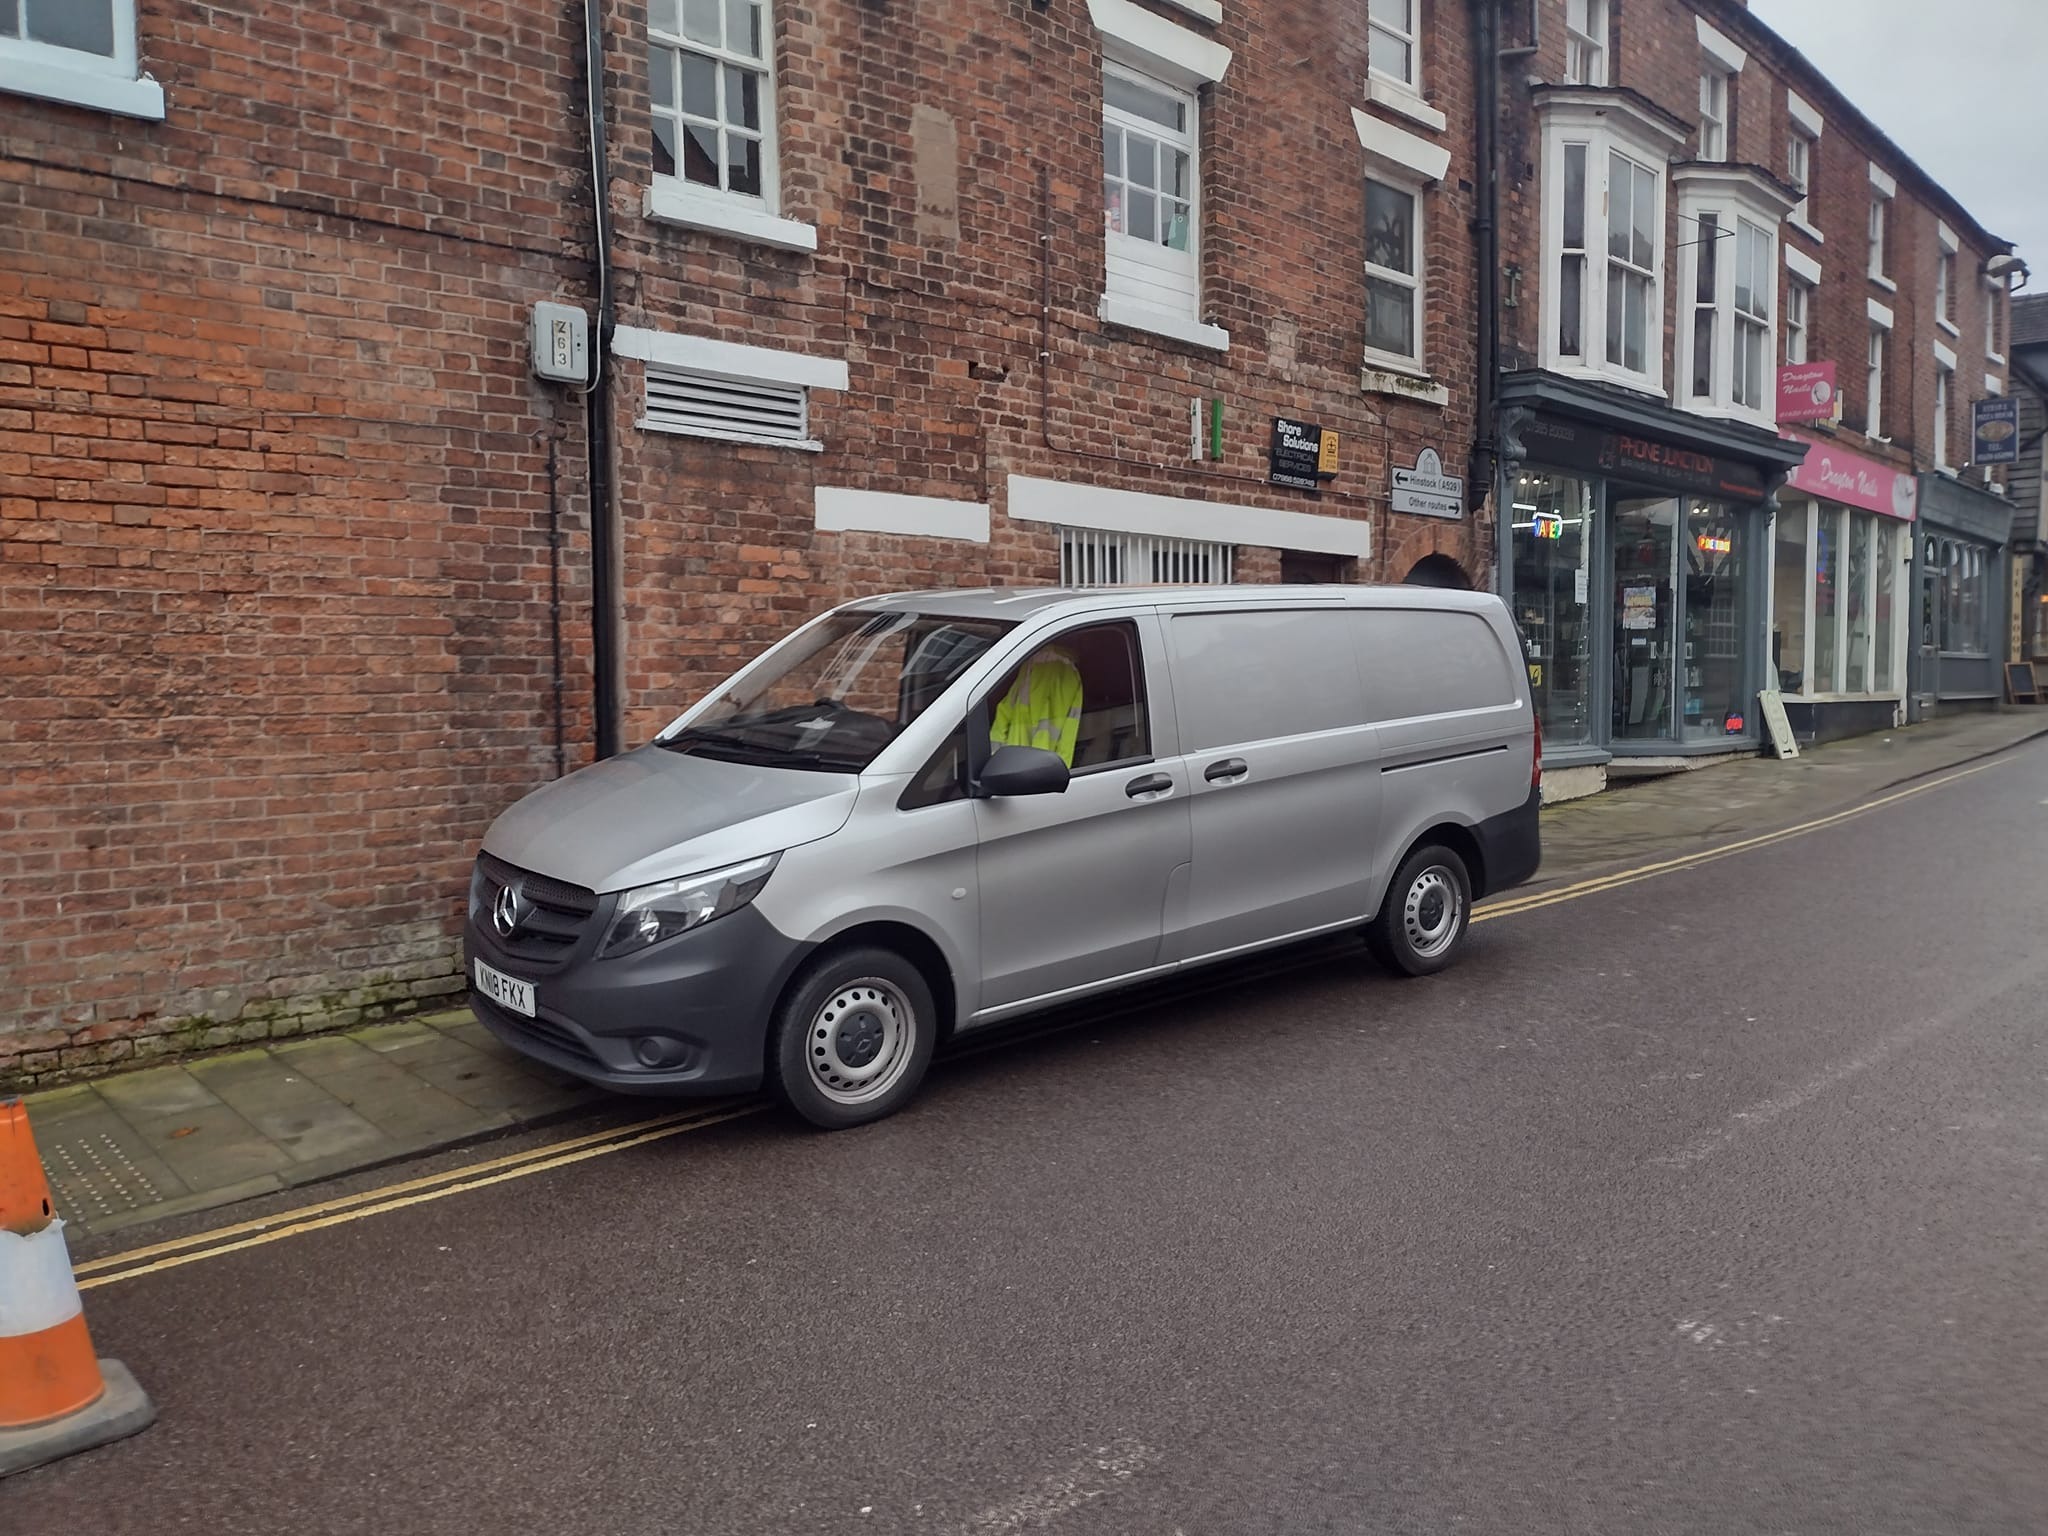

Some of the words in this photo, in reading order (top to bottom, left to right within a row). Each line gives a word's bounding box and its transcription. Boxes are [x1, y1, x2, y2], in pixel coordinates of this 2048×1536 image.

[1782, 371, 1824, 382] Drayton
[1783, 383, 1811, 394] Nails
[1278, 420, 1302, 437] Shore
[1282, 434, 1319, 453] Solutions
[1620, 436, 1661, 463] PHONE
[1662, 446, 1714, 473] JUNCTION
[1409, 474, 1437, 489] Hinstock
[1438, 479, 1461, 493] (A529)
[1820, 457, 1855, 491] Drayton
[1858, 470, 1878, 497] Nails
[1408, 496, 1427, 507] Other
[1427, 501, 1447, 511] routes
[479, 965, 500, 997] KN18
[501, 977, 526, 1009] FKX
